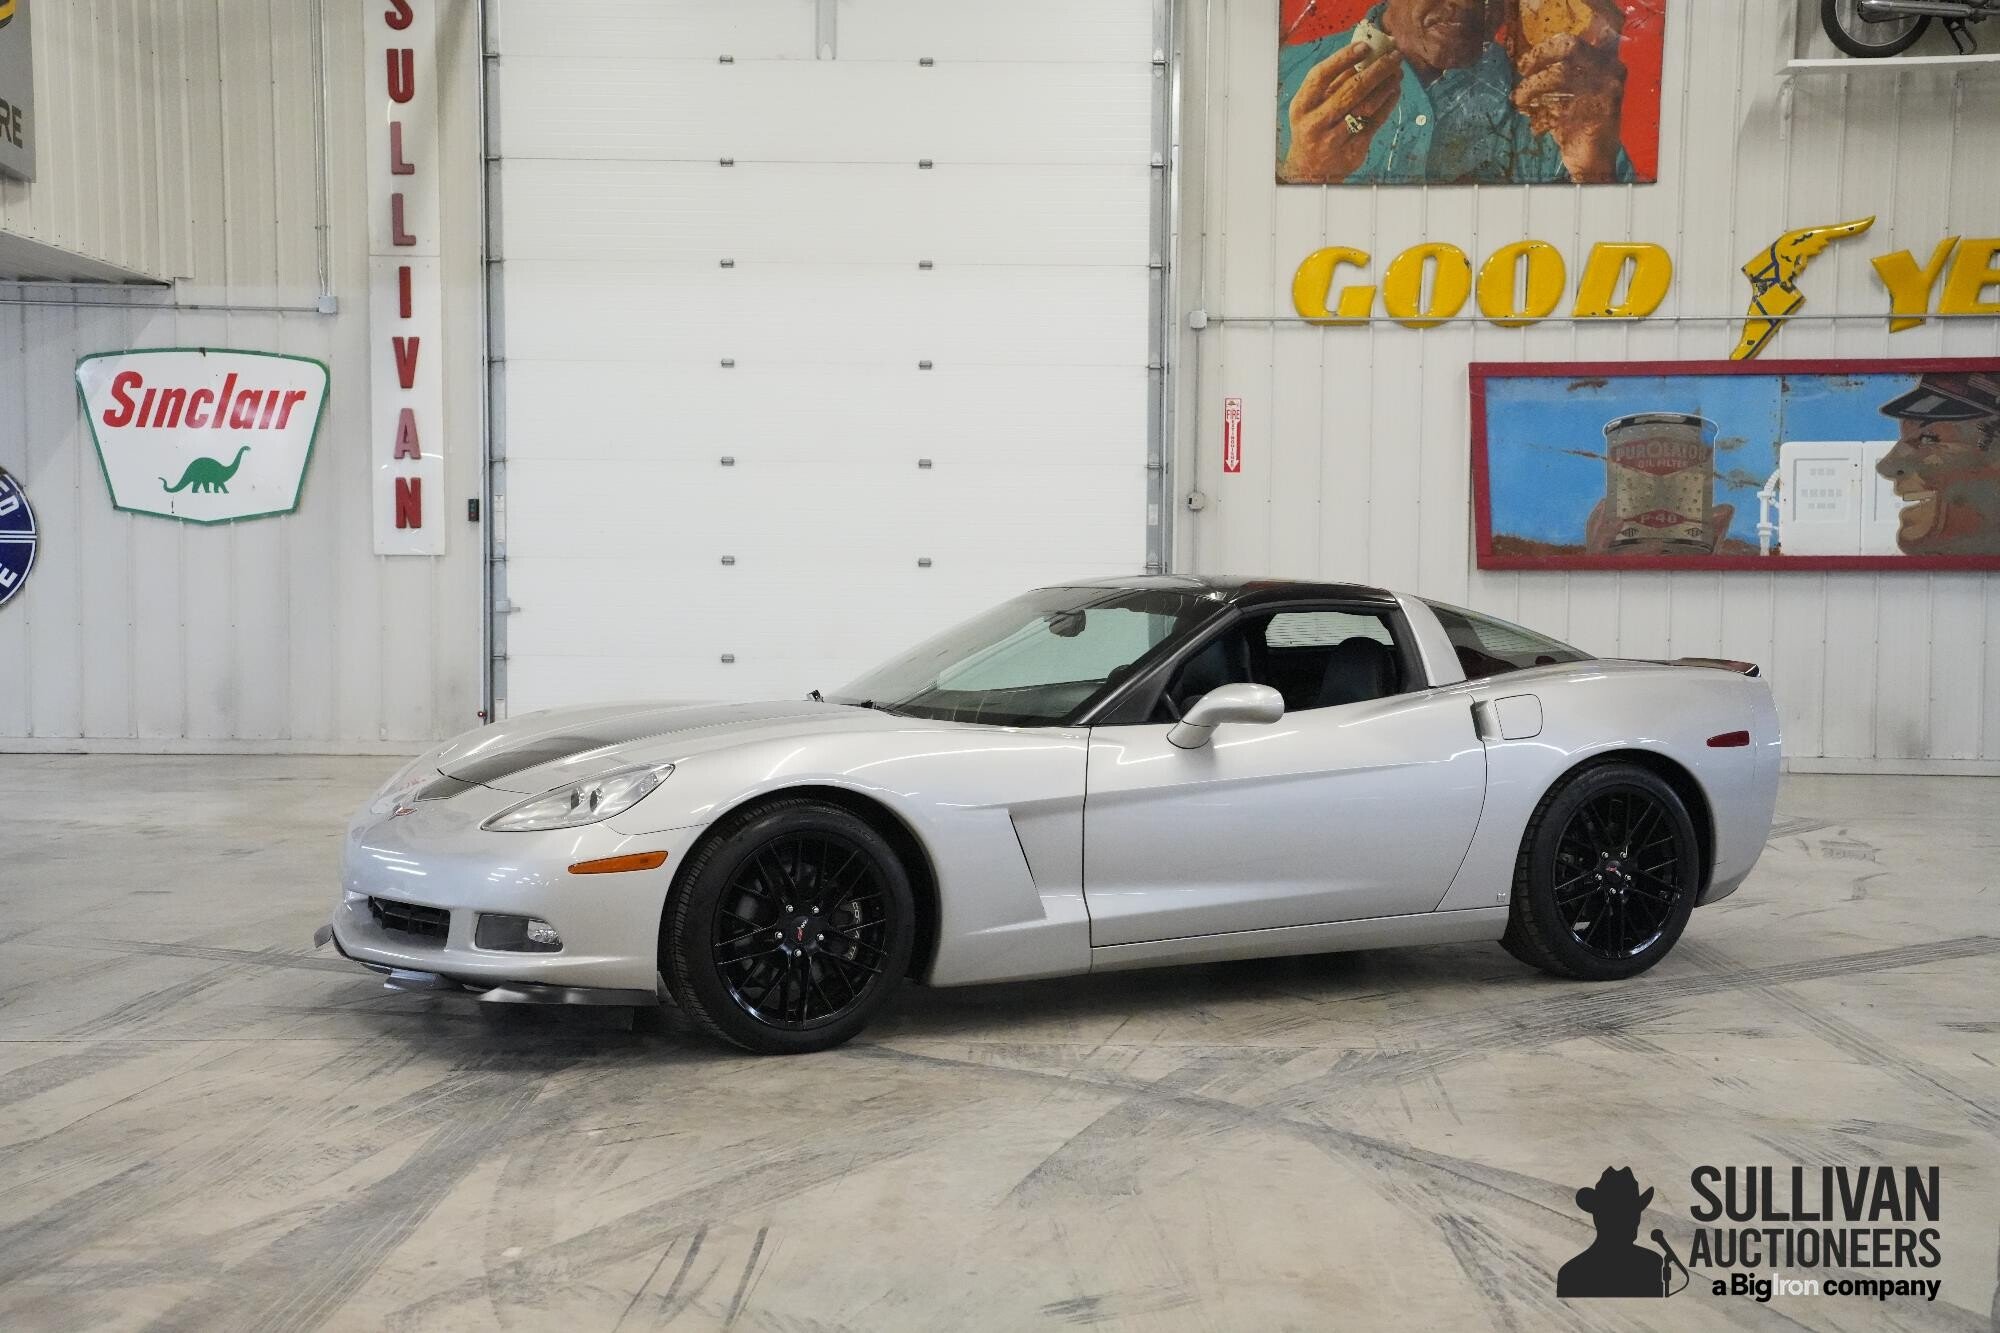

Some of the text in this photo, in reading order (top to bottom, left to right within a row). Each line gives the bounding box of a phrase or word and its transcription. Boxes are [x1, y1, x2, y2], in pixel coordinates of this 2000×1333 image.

[384, 0, 422, 529] SULLIVAN
[1292, 235, 2000, 331] GOOD YE
[102, 371, 307, 430] Sinclair
